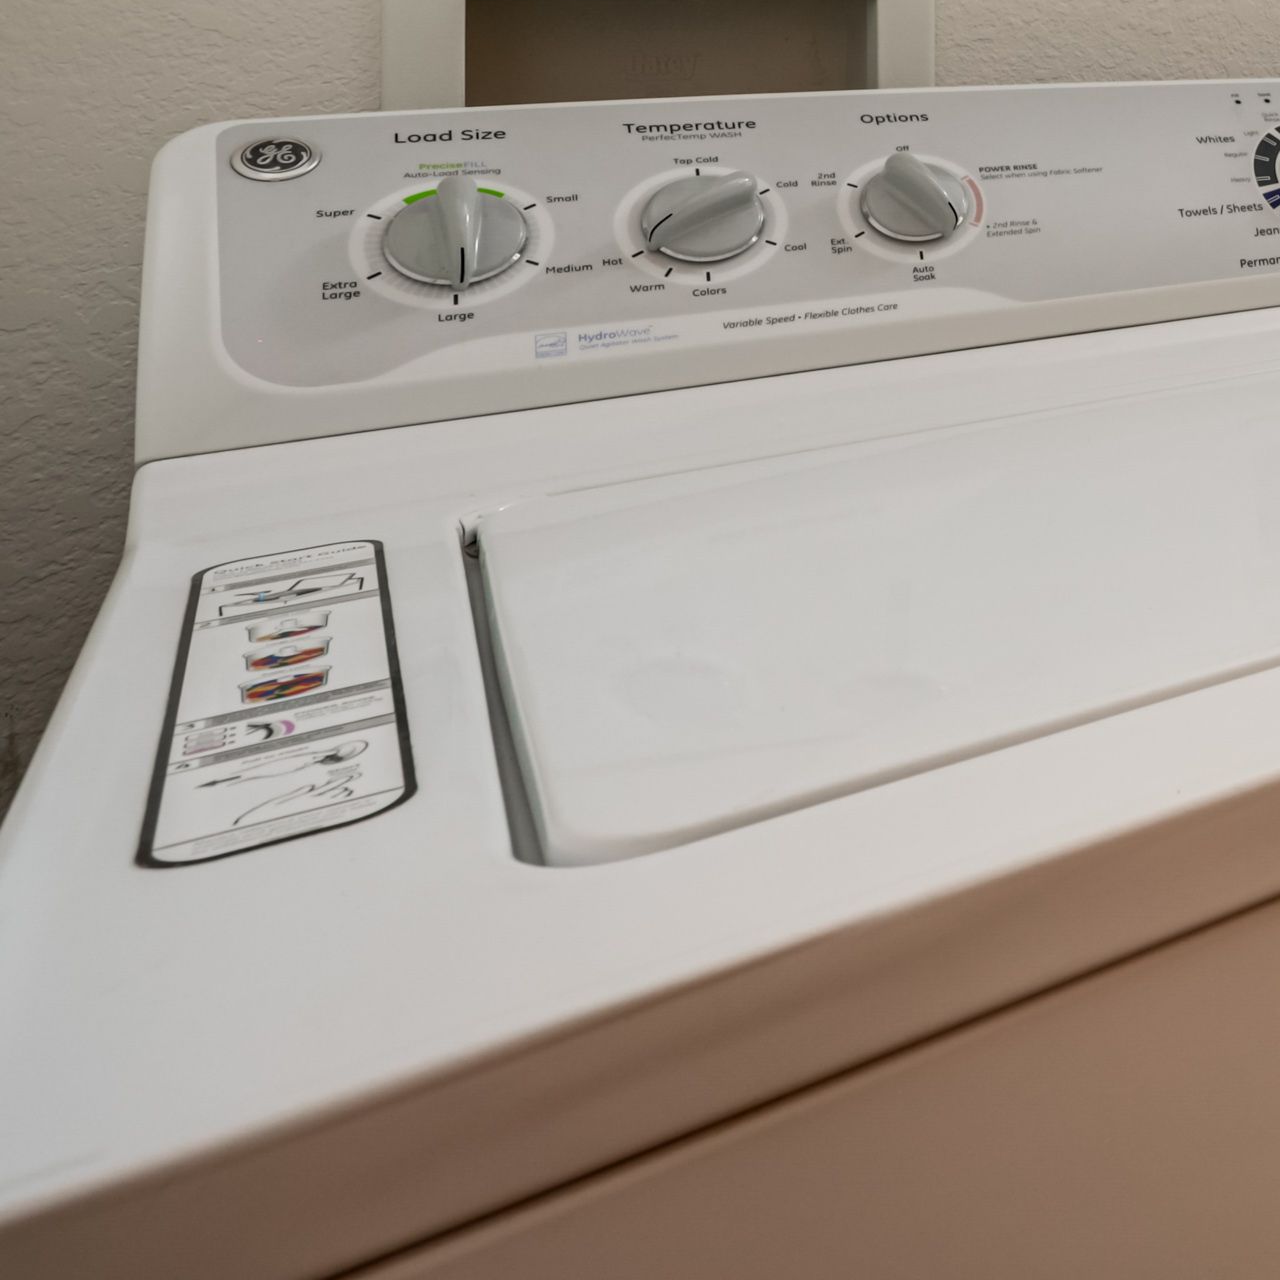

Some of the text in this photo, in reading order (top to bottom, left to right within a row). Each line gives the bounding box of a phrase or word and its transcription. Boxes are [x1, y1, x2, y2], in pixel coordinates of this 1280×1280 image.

[860, 113, 929, 126] Options
[623, 119, 757, 135] Temperature
[394, 128, 507, 144] Load Size
[642, 131, 742, 142] PerfecTemp WASH
[1196, 136, 1236, 144] Whites
[695, 156, 719, 164] Cold
[978, 163, 1038, 173] POWER RINSE
[776, 180, 799, 188] Cold
[546, 194, 579, 204] Small
[316, 208, 355, 218] Super
[1178, 206, 1218, 218] Towels
[1227, 202, 1264, 214] Sheets
[784, 243, 807, 252] Cool
[831, 245, 853, 254] Spin
[602, 258, 623, 267] Hot
[545, 263, 593, 274] Medium
[912, 264, 935, 275] Auto
[913, 273, 936, 282] Soak
[322, 281, 358, 291] Extra
[630, 283, 665, 293] Warm
[322, 290, 361, 300] Large
[692, 287, 727, 297] Colors
[438, 312, 475, 322] Large
[723, 303, 898, 329] Variable Speed Flexible Clothes Care
